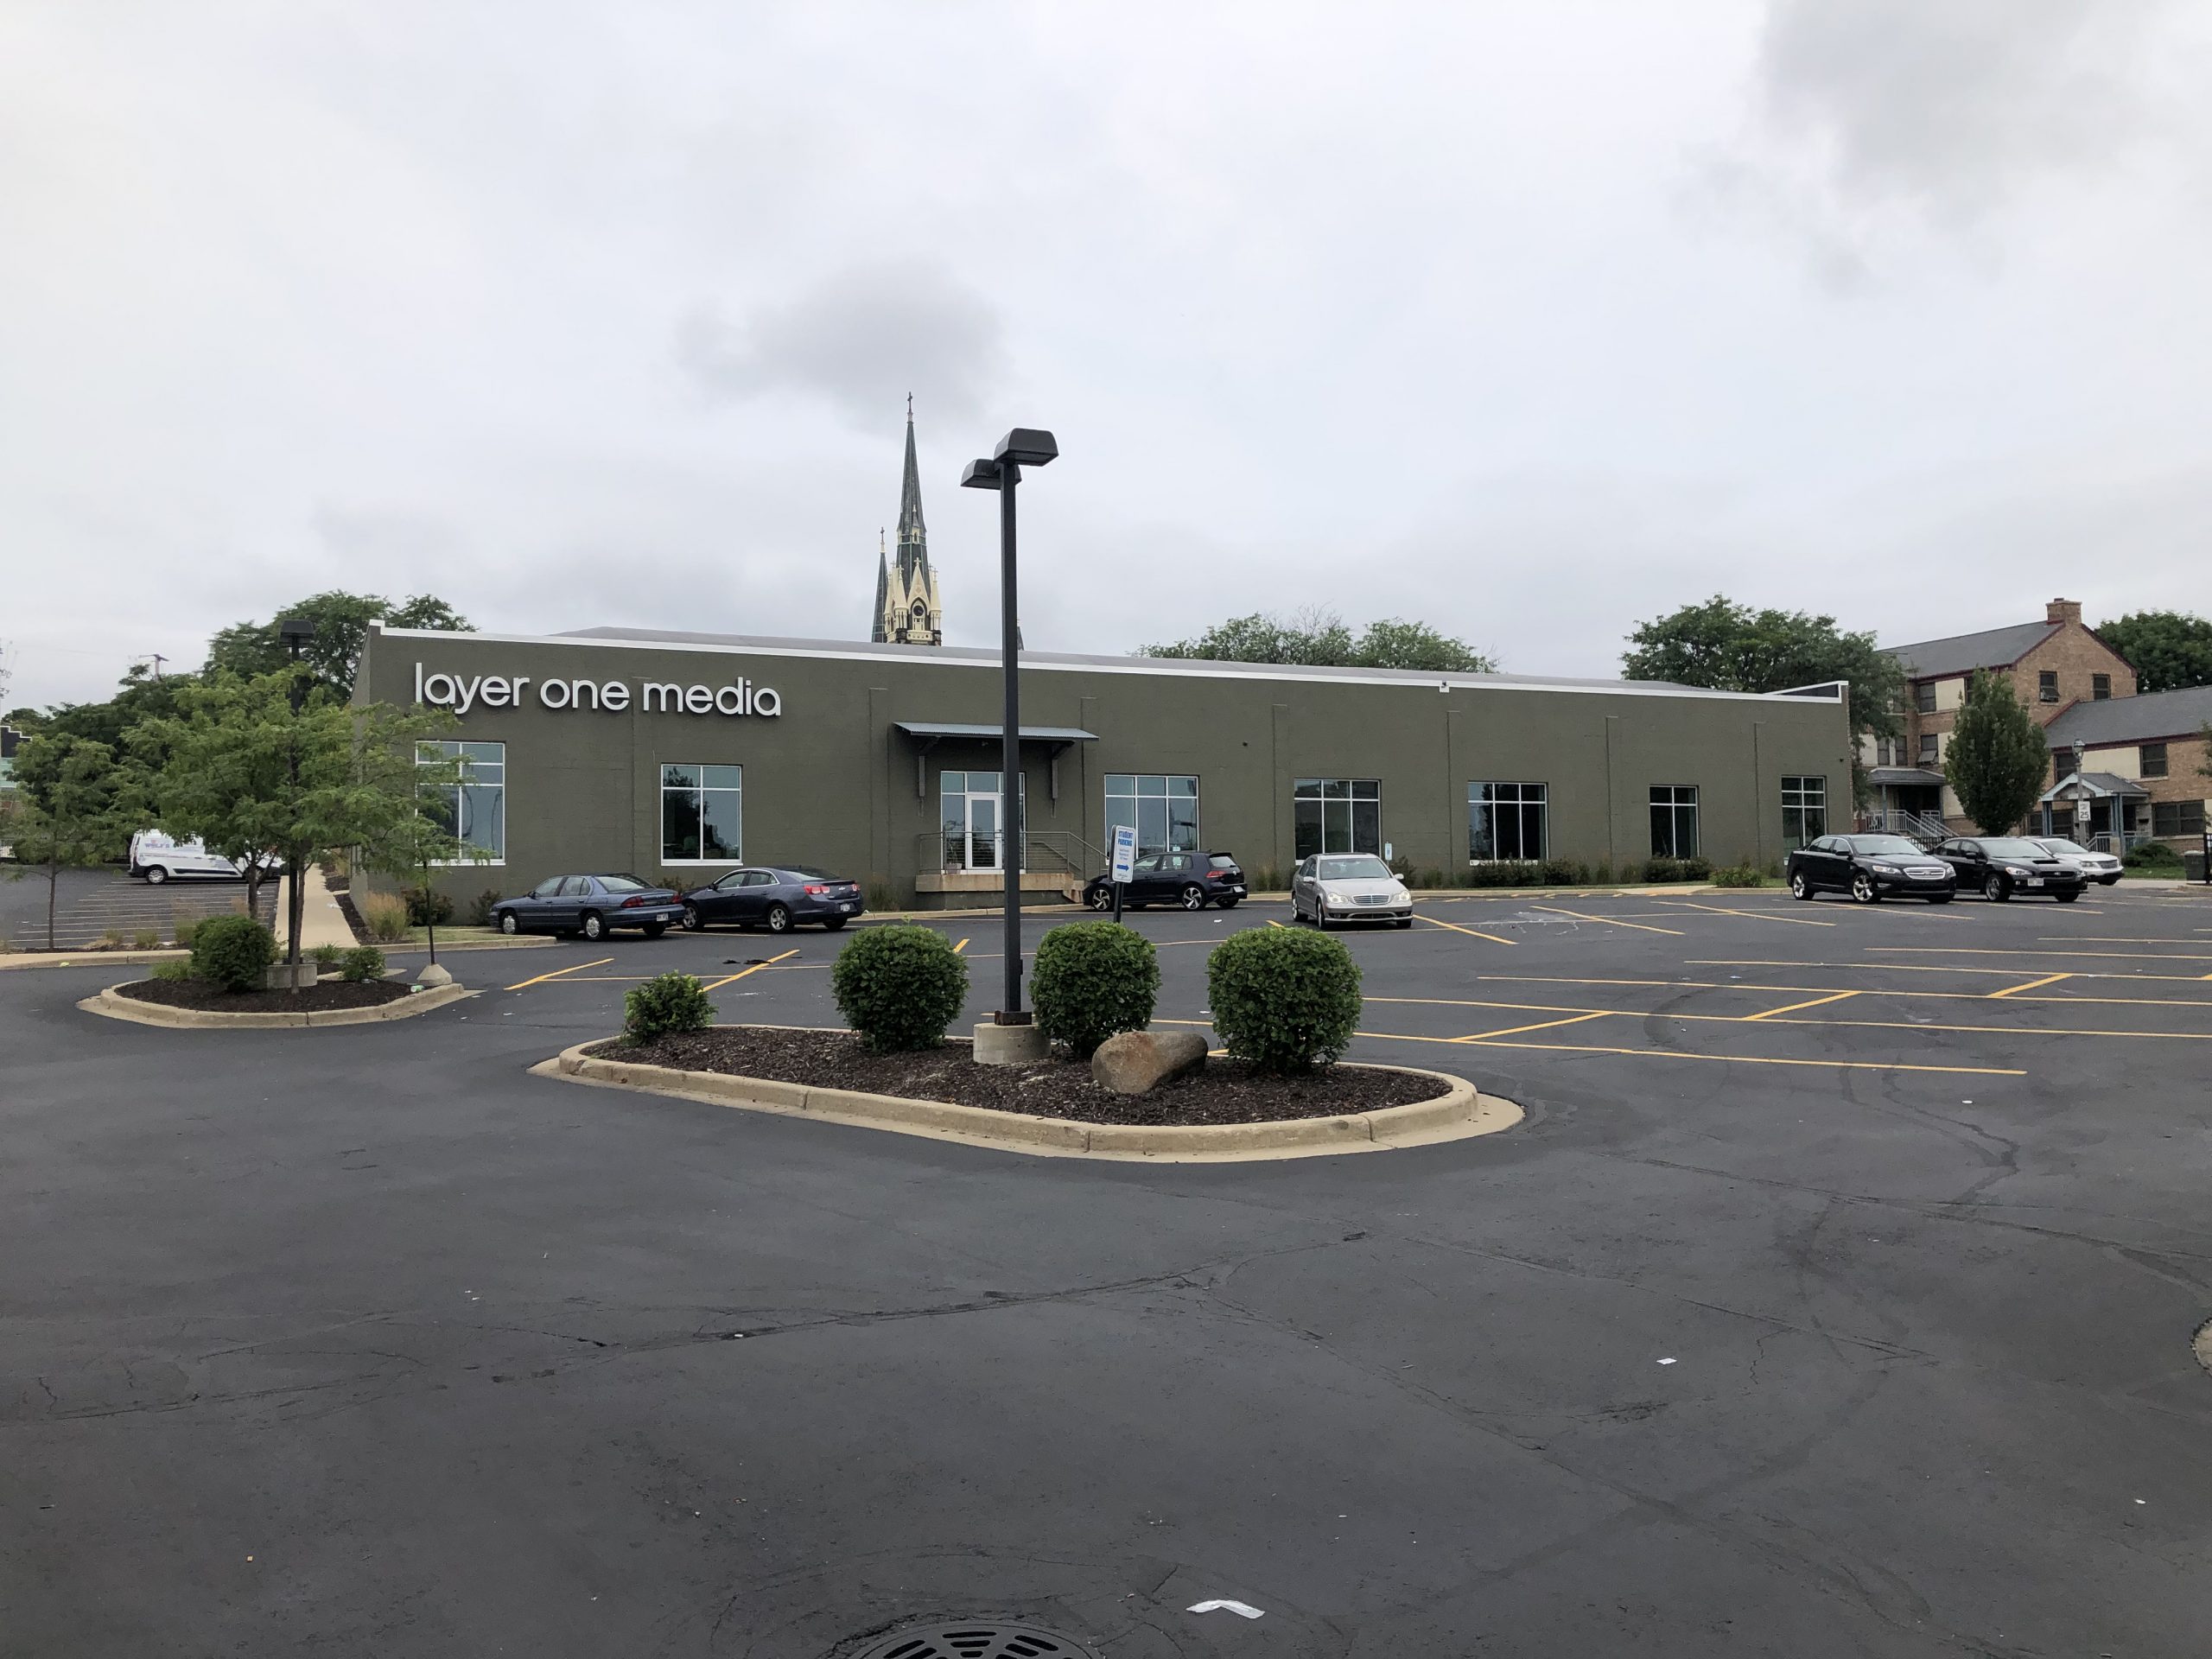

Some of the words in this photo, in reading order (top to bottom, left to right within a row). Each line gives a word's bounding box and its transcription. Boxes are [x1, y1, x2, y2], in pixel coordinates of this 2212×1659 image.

[415, 662, 531, 715] layer
[540, 678, 630, 711] one
[643, 677, 782, 716] media
[2080, 810, 2089, 819] 25
[1118, 830, 1134, 839] STUDENT
[1117, 838, 1133, 847] PARKING
